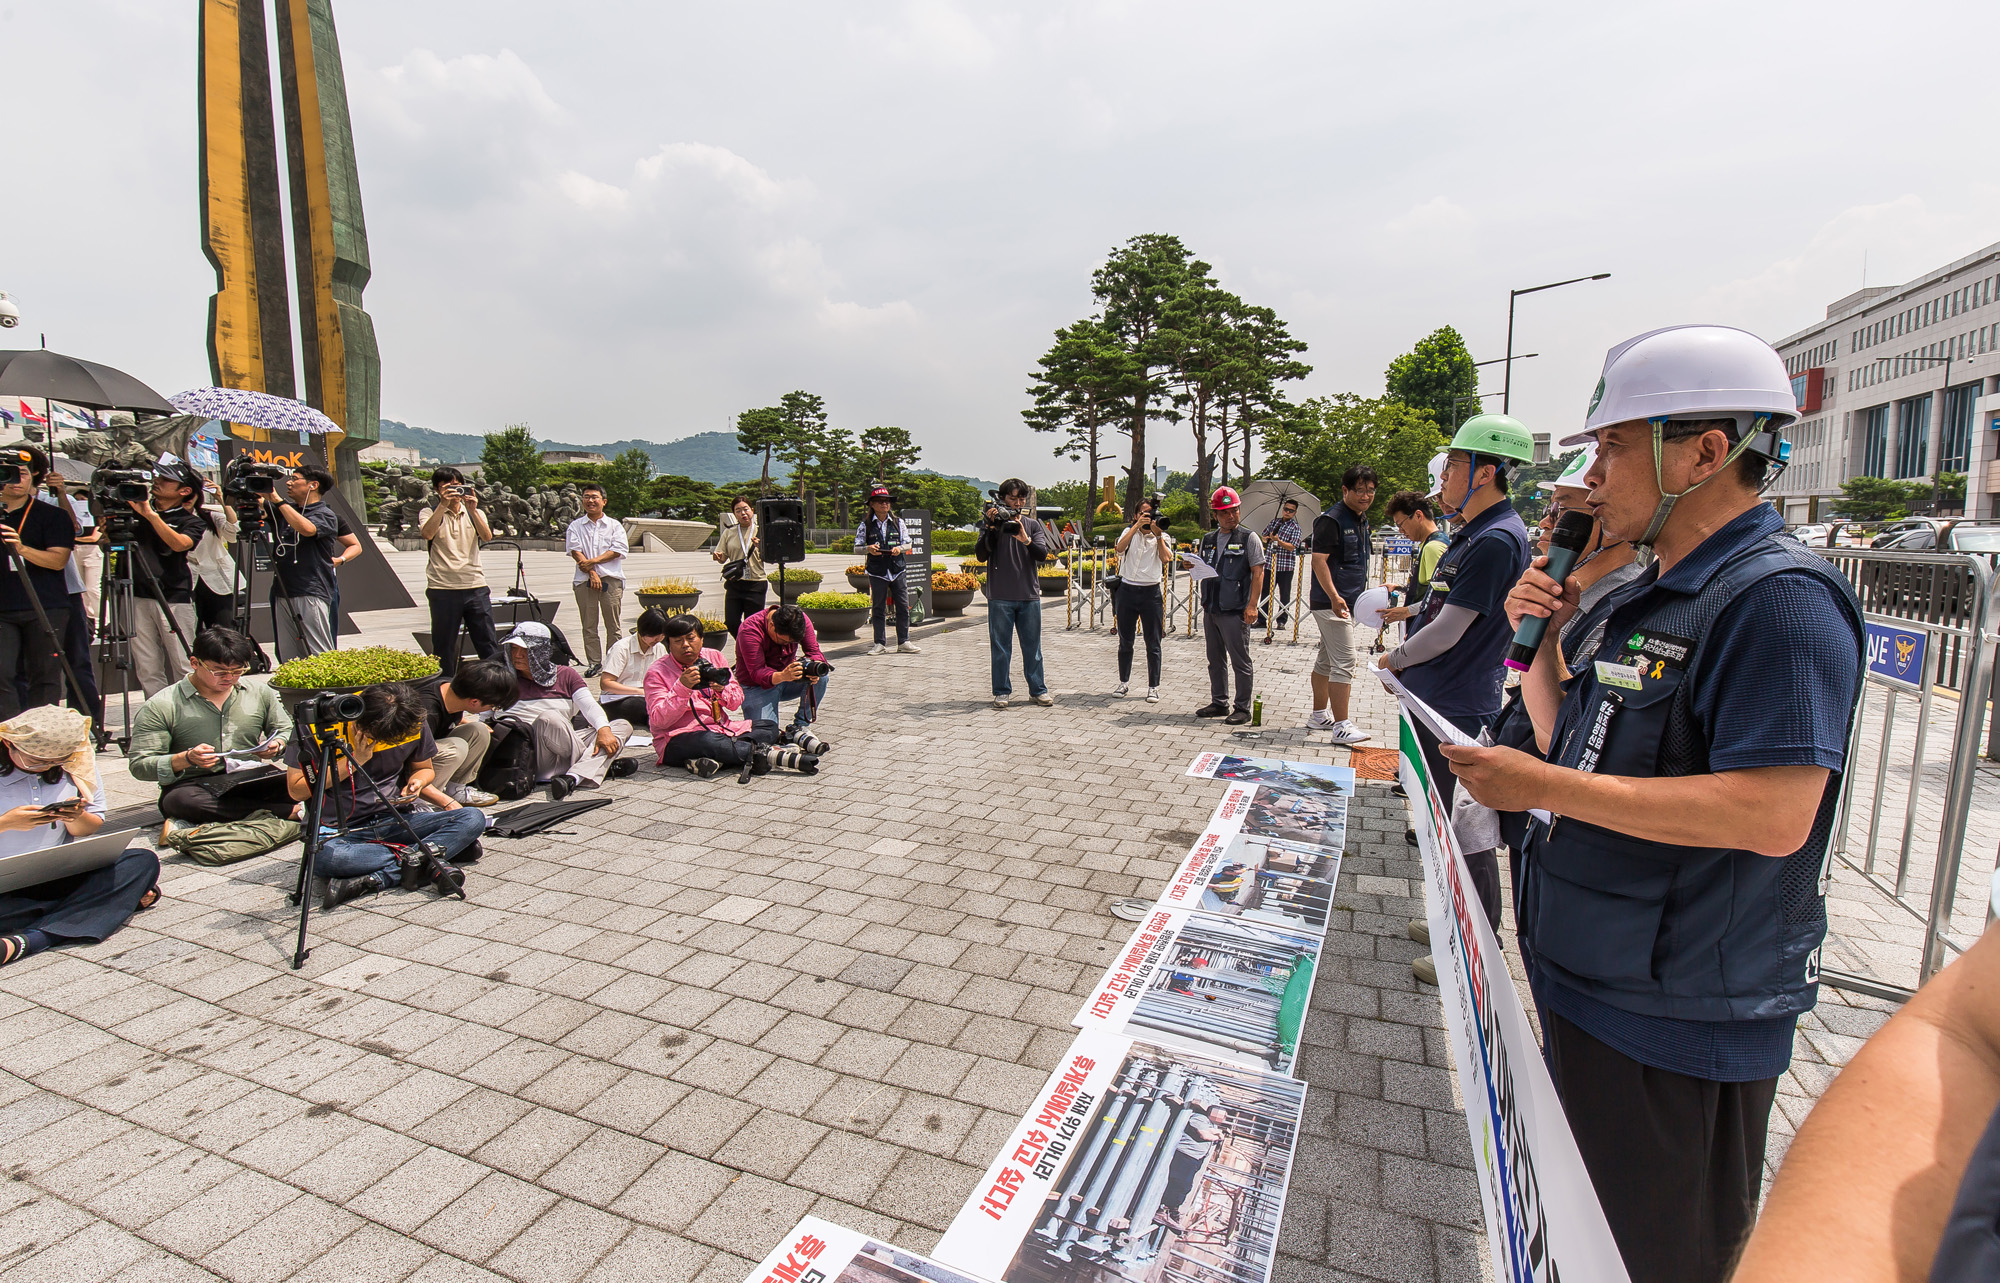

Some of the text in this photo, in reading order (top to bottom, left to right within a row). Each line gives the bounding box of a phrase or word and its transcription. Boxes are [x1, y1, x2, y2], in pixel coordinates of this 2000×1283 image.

[1866, 633, 1890, 664] NE
[1638, 666, 1648, 675] 20
[1588, 701, 1610, 746] 열사정신
[1595, 705, 1615, 750] 노조탄압
[1185, 846, 1212, 872] 휴게실에서
[1178, 872, 1196, 884] 쉬고
[1168, 884, 1189, 901] 싶다!
[1089, 911, 1172, 1019] 안전한 휴게실에서 쉬고 싶다!
[1144, 950, 1161, 965] 자재
[1135, 964, 1154, 978] 위가
[1122, 977, 1145, 999] 아니라
[978, 1054, 1096, 1221] 휴게실에서 쉬고 싶다!
[1032, 1091, 1095, 1181] 자재 위가 아니라
